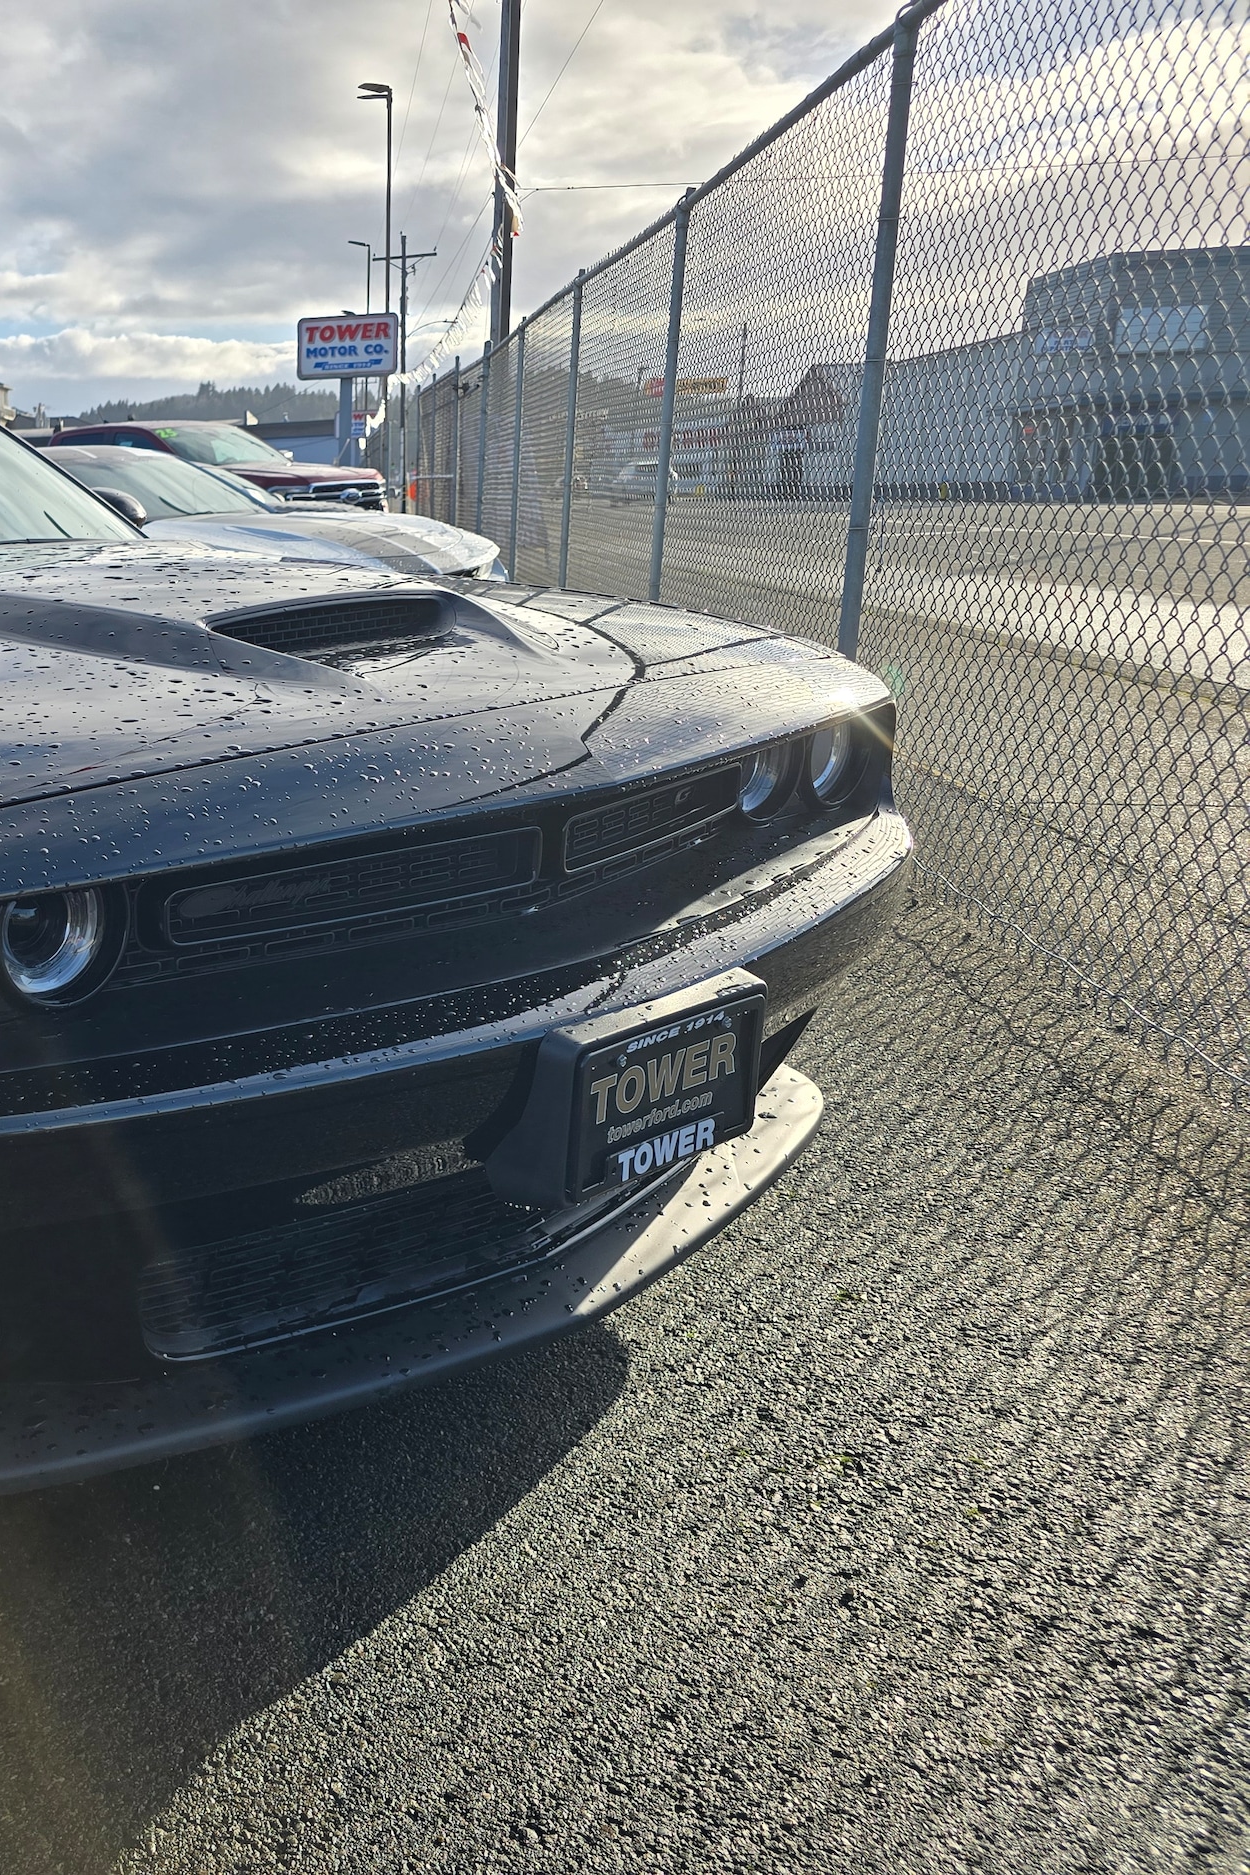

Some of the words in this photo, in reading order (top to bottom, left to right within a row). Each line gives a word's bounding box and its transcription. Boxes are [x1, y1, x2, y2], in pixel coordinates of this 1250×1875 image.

[306, 322, 391, 344] TOWER
[306, 345, 359, 359] MOTOR
[364, 343, 389, 355] CO.
[155, 427, 177, 438] 25
[626, 1026, 681, 1053] SINCE
[686, 1011, 725, 1032] 1914
[591, 1032, 737, 1125] TOWER
[607, 1091, 713, 1143] towerford.com
[618, 1117, 716, 1182] TOWER
